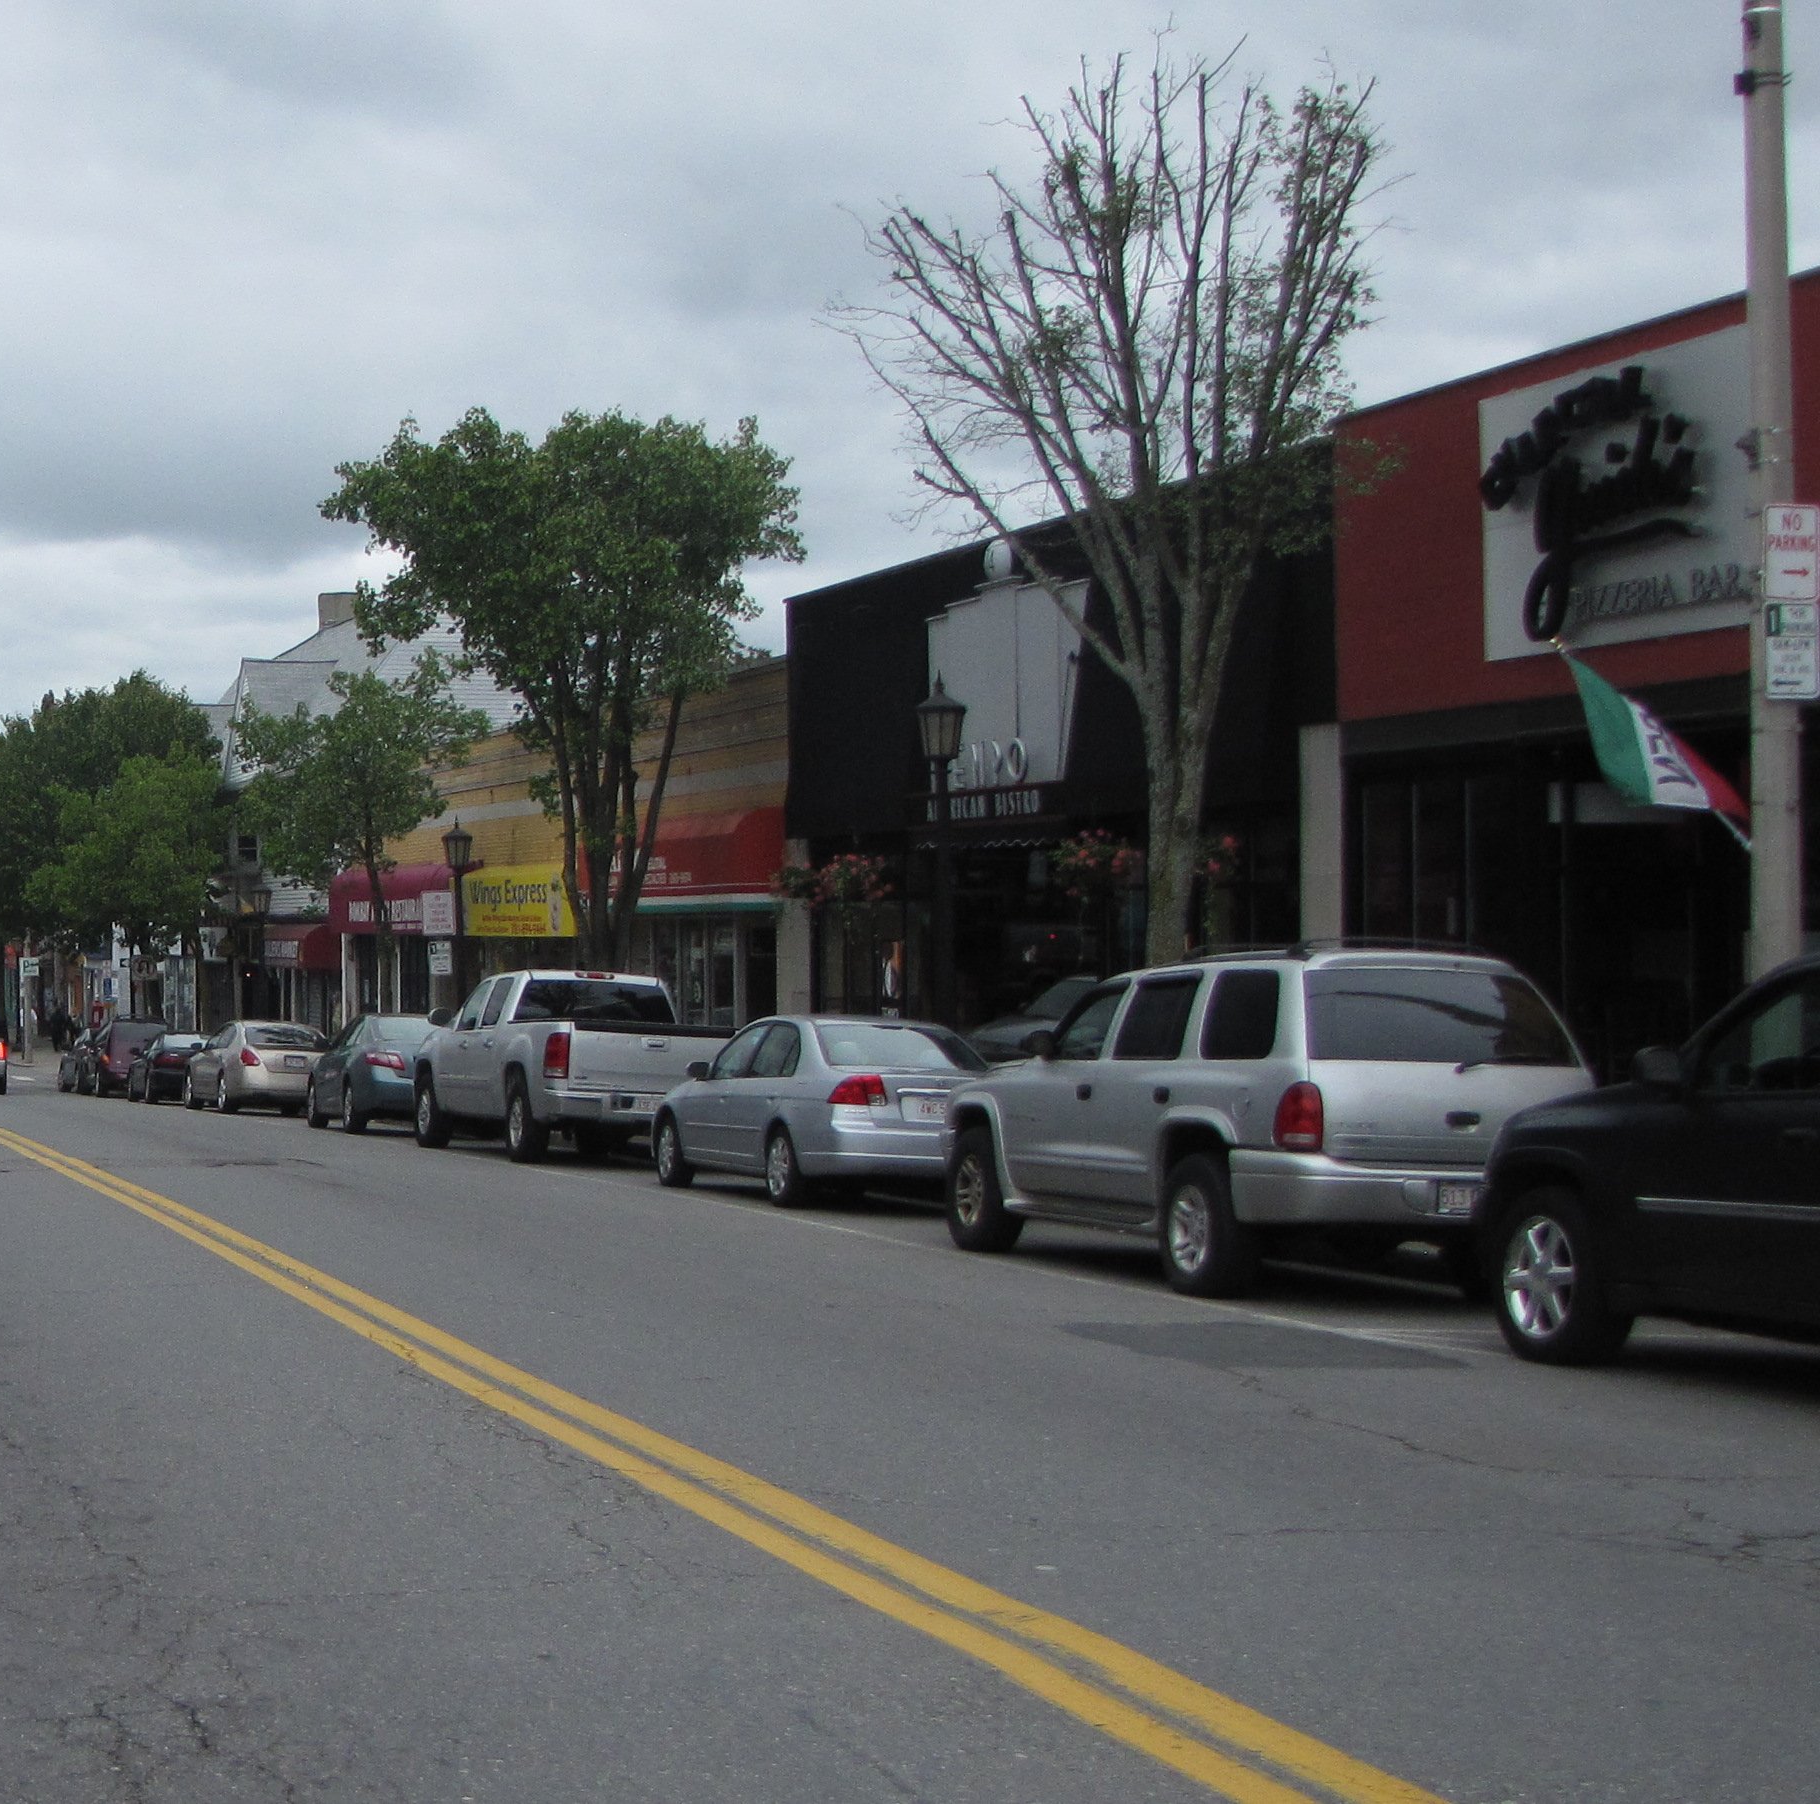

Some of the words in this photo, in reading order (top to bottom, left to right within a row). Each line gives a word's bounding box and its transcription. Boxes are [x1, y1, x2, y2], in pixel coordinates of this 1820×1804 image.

[1781, 513, 1803, 532] NO
[1767, 535, 1815, 551] PARKING
[1690, 563, 1742, 602] BAR
[926, 794, 987, 823] ARICAN
[994, 788, 1041, 816] BISTRO
[469, 879, 502, 913] Wings
[504, 879, 548, 912] Express
